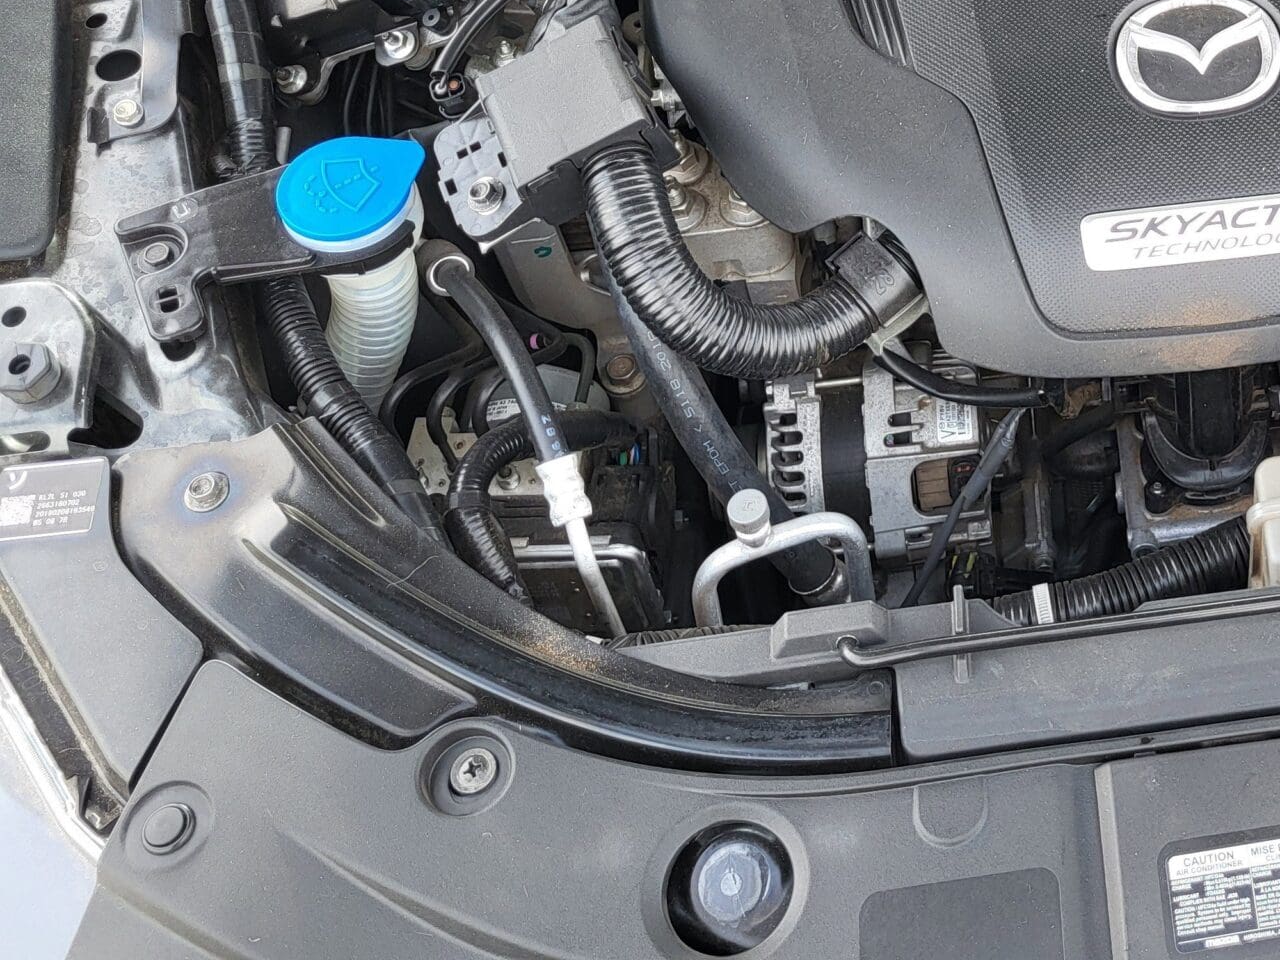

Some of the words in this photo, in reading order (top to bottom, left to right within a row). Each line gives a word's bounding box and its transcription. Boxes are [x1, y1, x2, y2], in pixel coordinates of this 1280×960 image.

[668, 379, 695, 419] 5118
[703, 440, 730, 476] EPDM
[1249, 844, 1275, 856] MISE
[1182, 851, 1234, 867] CAUTION
[1175, 868, 1189, 876] AIR
[1190, 859, 1243, 874] CONDITIONER
[1204, 934, 1240, 948] mazda
